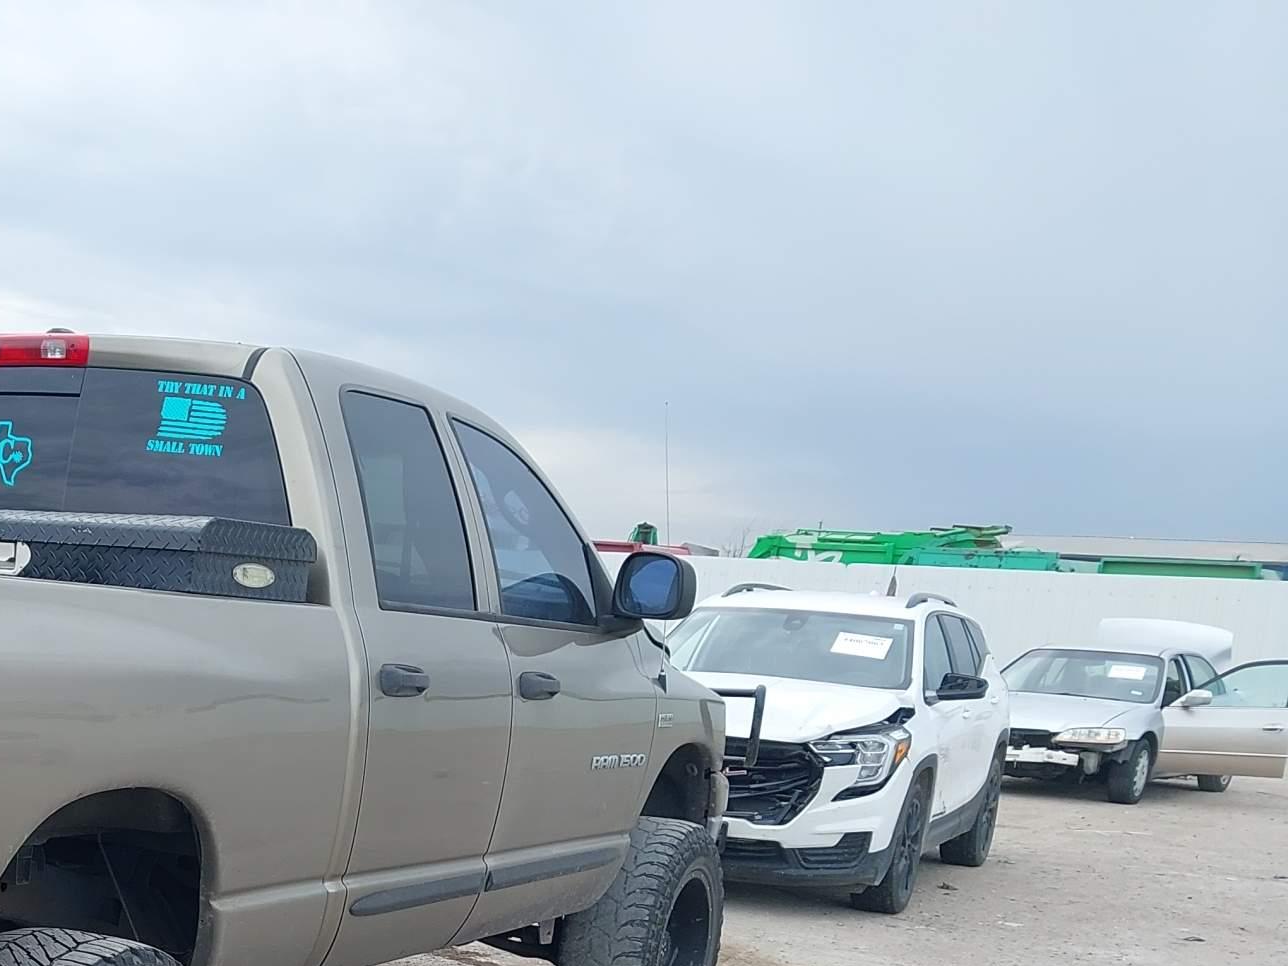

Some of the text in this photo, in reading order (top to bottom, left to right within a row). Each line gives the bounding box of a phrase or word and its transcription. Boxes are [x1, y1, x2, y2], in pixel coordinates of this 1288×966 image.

[157, 380, 246, 400] TRY THAT IN A
[146, 439, 223, 457] SMALL TOWN
[591, 753, 647, 770] RAM 1500
